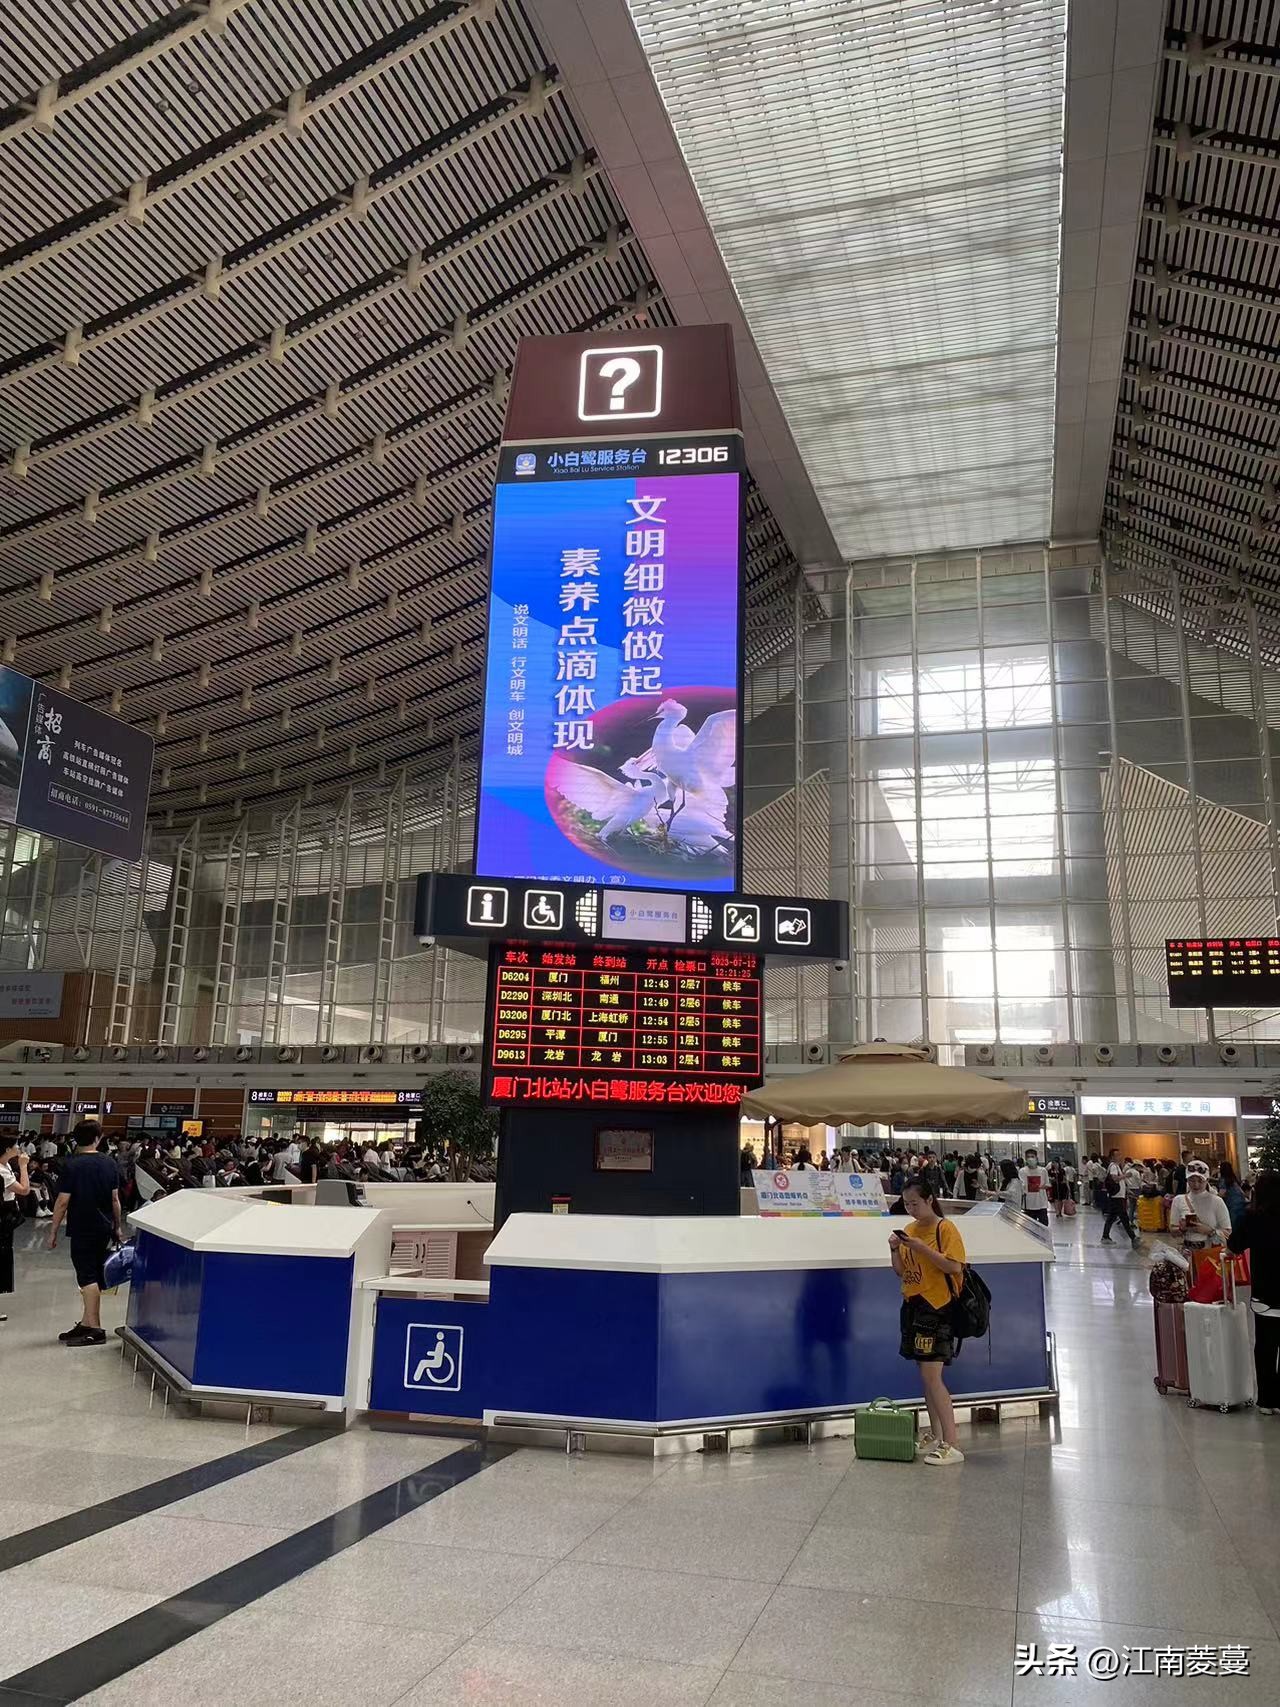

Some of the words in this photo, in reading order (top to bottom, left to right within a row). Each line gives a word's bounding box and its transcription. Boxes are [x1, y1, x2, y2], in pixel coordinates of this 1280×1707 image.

[547, 448, 647, 467] 小白鹭服务台
[658, 446, 729, 465] 12306
[620, 496, 666, 696] 文明细微做起
[511, 603, 529, 649] 说文明话
[553, 548, 600, 750] 素养点滴体现
[509, 656, 527, 702] 行文明车
[36, 707, 63, 766] 招商
[506, 709, 524, 756] 创文明城
[504, 951, 529, 964] 车次
[542, 952, 576, 967] 始发站
[593, 954, 627, 968] 终到站
[646, 958, 668, 971] 开点
[674, 959, 706, 973] 检票口
[711, 957, 756, 968] 2023-07-12
[502, 972, 529, 982] D6204
[548, 972, 568, 983] 厦门
[600, 975, 620, 986] 福州
[643, 979, 669, 988] 12:43
[680, 979, 700, 989] 2层7
[722, 981, 741, 992] 候车
[501, 991, 529, 1001] D2290
[541, 991, 573, 1002] 深圳北
[599, 993, 619, 1004] 南通
[643, 997, 669, 1007] 12:49
[680, 998, 700, 1008] 2层6
[722, 999, 741, 1010] 候车
[500, 1010, 527, 1020] D3206
[541, 1010, 572, 1021] 厦门北
[588, 1012, 628, 1024] 上海虹桥
[642, 1016, 668, 1026] 12:54
[680, 1016, 700, 1026] 2层5
[722, 1018, 741, 1028] 候车
[499, 1029, 526, 1039] D6295
[545, 1029, 566, 1040] 平潭
[598, 1031, 618, 1042] 厦门
[642, 1035, 668, 1045] 12:55
[680, 1035, 699, 1045] 1层1
[722, 1036, 741, 1047] 候车
[497, 1050, 525, 1059] D9613
[544, 1049, 565, 1060] 龙岩
[641, 1055, 667, 1064] 13:03
[679, 1054, 699, 1065] 2层4
[722, 1056, 741, 1067] 候车
[251, 1091, 258, 1101] 8
[398, 1092, 405, 1102] 8
[1038, 1099, 1046, 1111] 6
